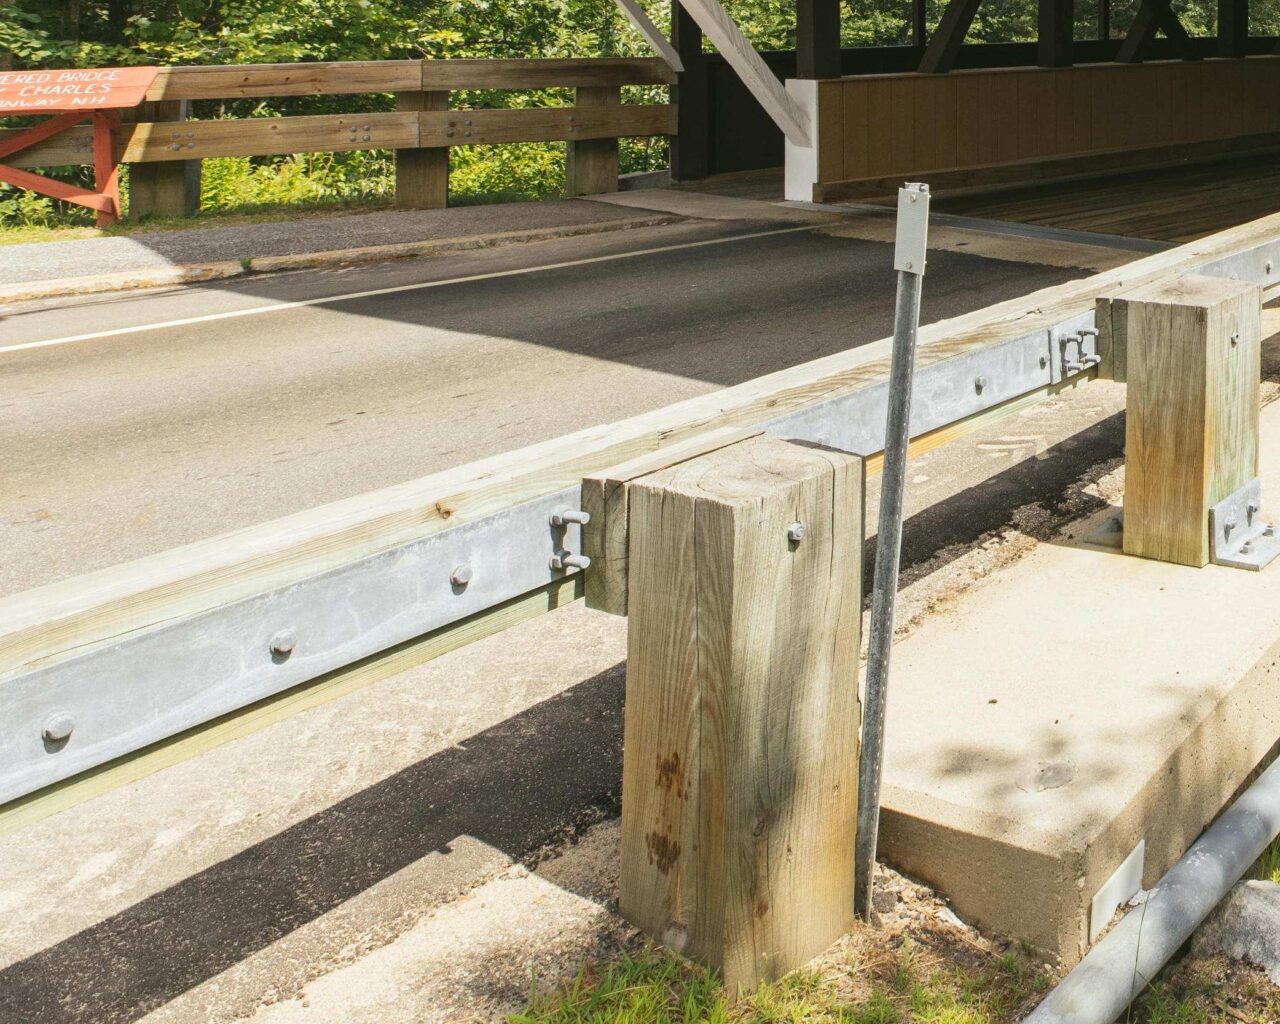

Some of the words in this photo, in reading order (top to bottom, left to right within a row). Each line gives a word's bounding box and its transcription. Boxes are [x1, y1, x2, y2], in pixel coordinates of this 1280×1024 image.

[57, 70, 123, 82] BRIDGE
[19, 83, 112, 96] CHARLES
[71, 96, 106, 105] NH
